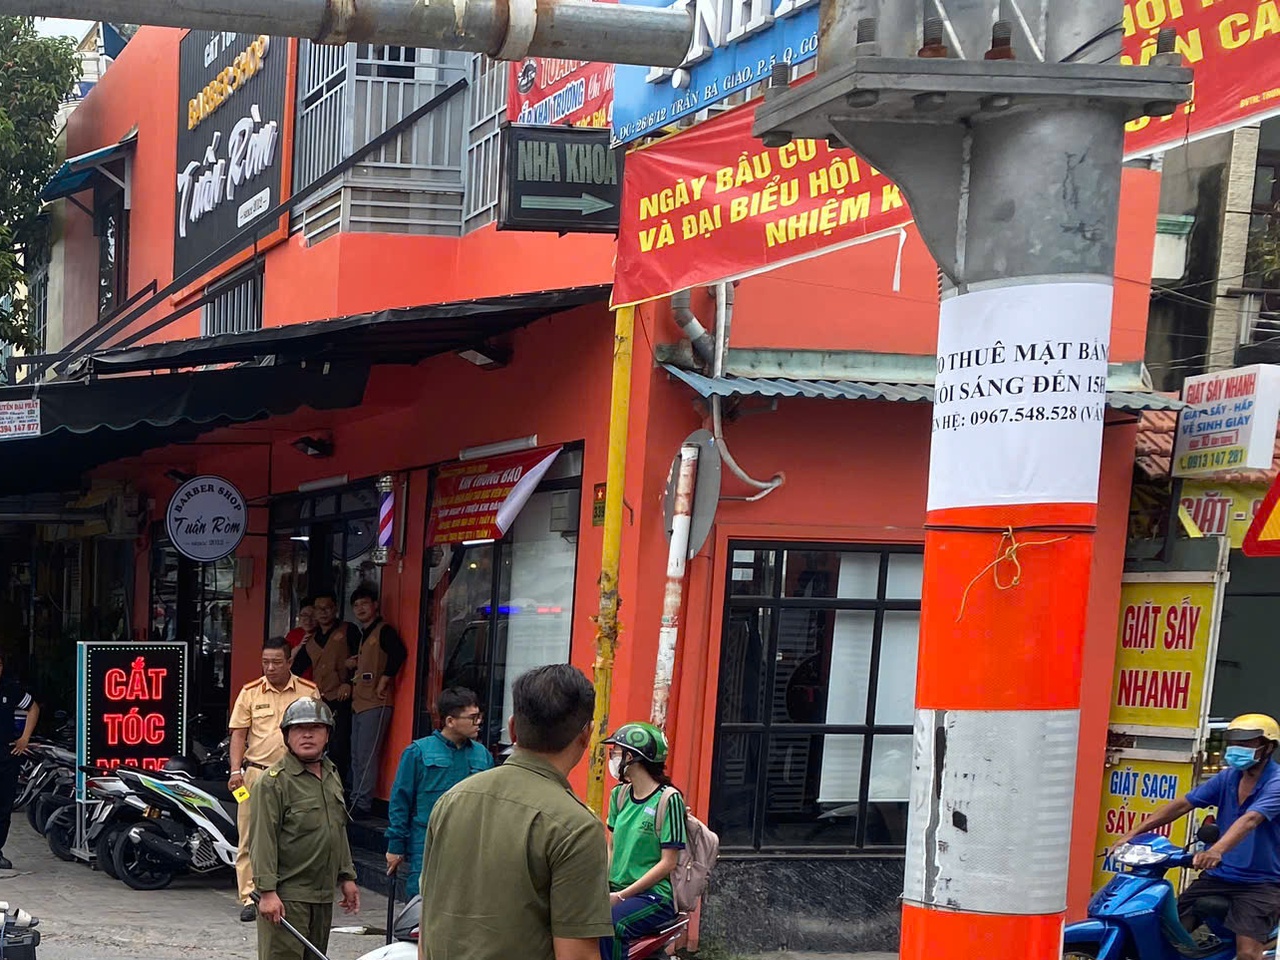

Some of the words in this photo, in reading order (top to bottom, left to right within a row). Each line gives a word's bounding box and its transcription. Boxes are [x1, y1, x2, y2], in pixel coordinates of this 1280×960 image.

[671, 88, 700, 116] TRẦN
[704, 77, 720, 102] BÁ
[517, 140, 561, 182] NHA
[565, 143, 618, 185] KHOA
[638, 219, 675, 253] VÀ
[682, 203, 723, 239] ĐẠI
[729, 174, 800, 224] BIỂU
[809, 156, 862, 199] HỘI
[639, 174, 708, 221] NGÀY
[715, 150, 772, 194] BẦU
[765, 190, 870, 248] NHIỆM
[881, 183, 905, 213] K
[948, 340, 1006, 371] THUÊ
[1014, 339, 1073, 366] MẶT
[959, 374, 1025, 401] SÁNG
[1032, 368, 1082, 394] ĐẾN
[1225, 372, 1257, 400] NHANH
[942, 411, 966, 431] HỆ:
[970, 405, 1078, 426] 0967.548.528
[1196, 420, 1223, 434] SINH
[174, 484, 215, 514] BARBER
[217, 486, 242, 512] SHOP
[174, 515, 207, 536] Tuấn
[212, 515, 240, 535] Ròm
[1121, 600, 1162, 655] GIẶT
[1163, 595, 1202, 650] SẤY
[104, 655, 168, 701] CẮT
[1116, 669, 1192, 711] NHANH
[103, 706, 166, 746] TÓC
[1109, 767, 1140, 802] GIẶT
[1140, 772, 1178, 804] SẠCH
